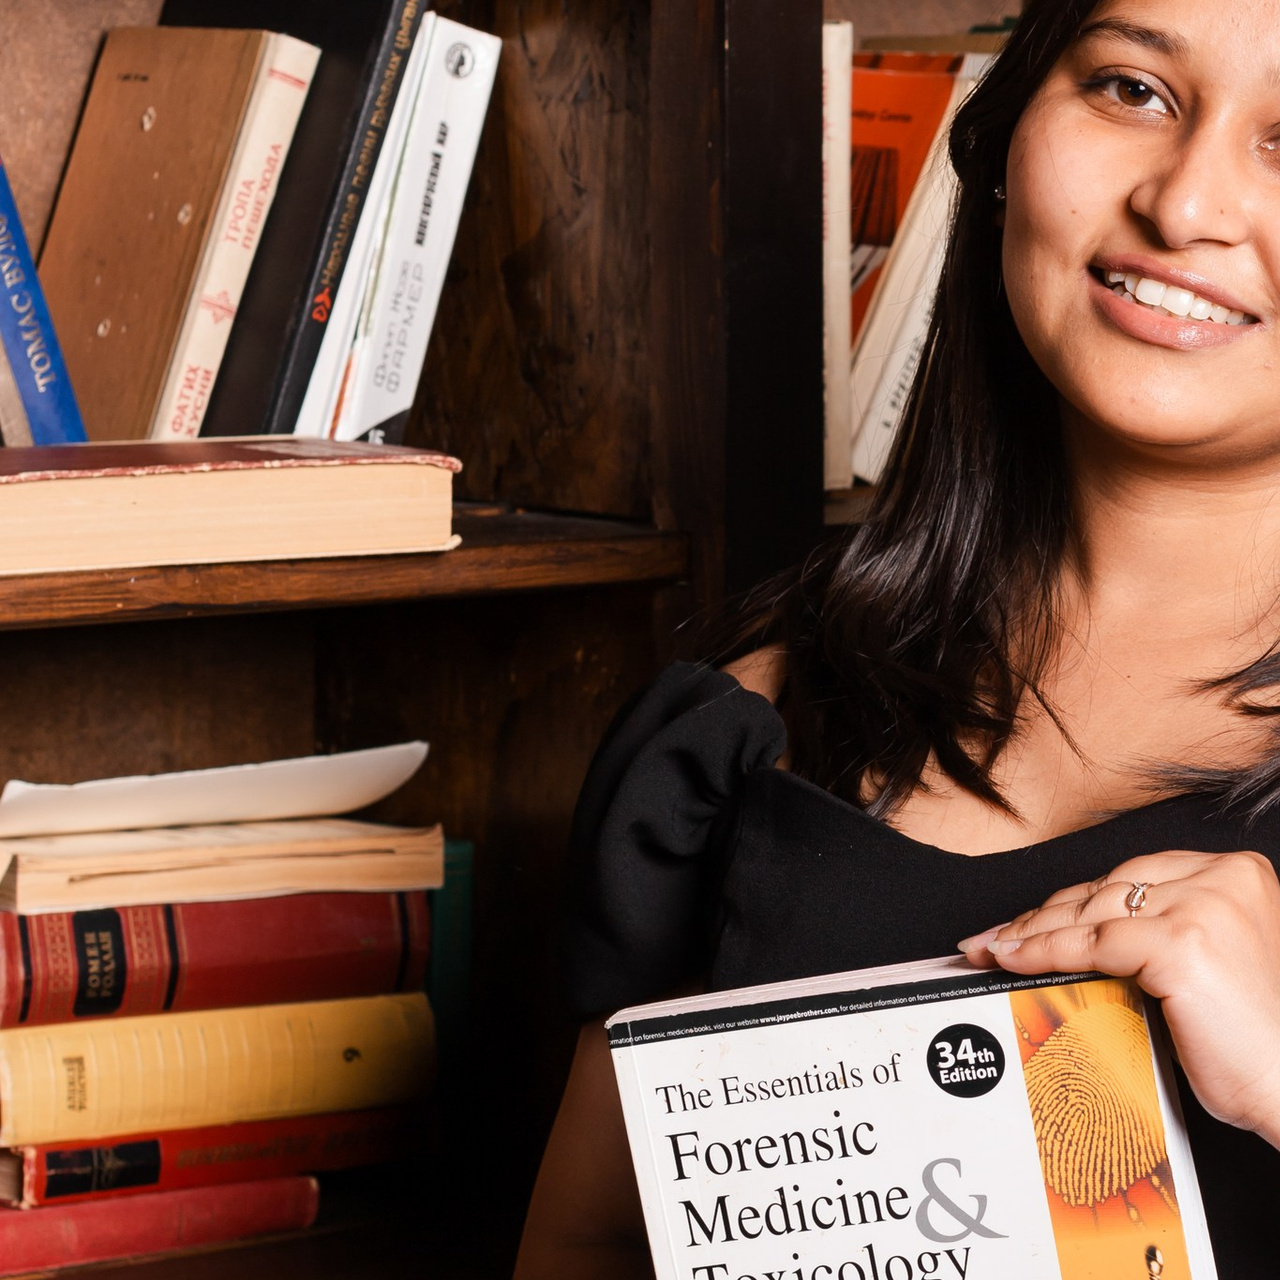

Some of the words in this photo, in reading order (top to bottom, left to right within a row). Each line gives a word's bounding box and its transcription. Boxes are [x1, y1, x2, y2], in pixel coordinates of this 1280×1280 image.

[222, 176, 258, 244] ТРОПА
[240, 140, 285, 253] ПЕШЕХОДА
[10, 284, 58, 393] ТОМАС
[385, 262, 428, 395] ФАРМЕР
[169, 361, 203, 437] ФАТИХ
[185, 366, 215, 440] ХУСНИ
[642, 1030, 667, 1042] forensic
[667, 1026, 693, 1038] medicine
[713, 1022, 725, 1031] visit
[725, 1021, 736, 1029] our
[736, 1017, 760, 1028] website
[760, 1005, 840, 1024] www.jaypeebrothers.com,
[840, 1003, 849, 1012] for
[849, 1000, 873, 1011] detailed
[873, 995, 907, 1008] information
[908, 995, 917, 1003] on
[917, 990, 940, 1002] forensic
[941, 986, 968, 998] medicine
[989, 983, 1001, 991] visit
[1001, 982, 1012, 990] our
[1012, 978, 1035, 988] website
[655, 1077, 714, 1115] The
[719, 1060, 864, 1107] Essentials
[872, 1052, 903, 1085] of
[934, 1038, 996, 1069] 34th
[938, 1064, 998, 1085] Edition
[664, 1109, 878, 1182] Forensic
[678, 1178, 912, 1248] Medicine
[915, 1157, 1010, 1244] &
